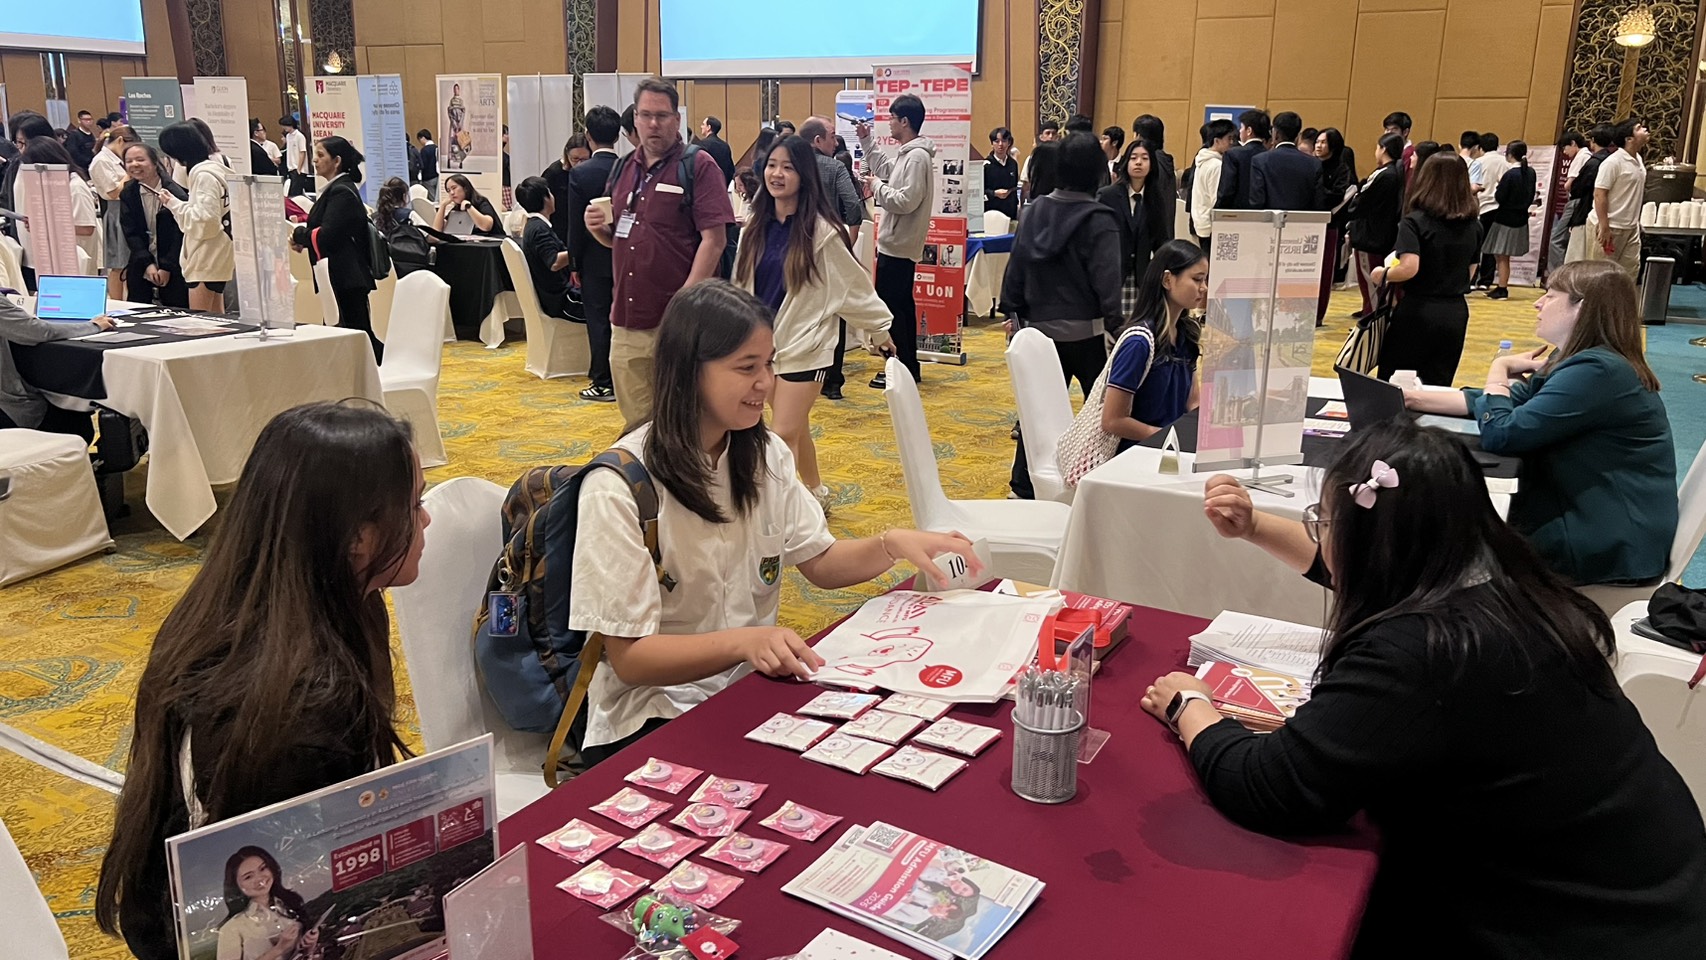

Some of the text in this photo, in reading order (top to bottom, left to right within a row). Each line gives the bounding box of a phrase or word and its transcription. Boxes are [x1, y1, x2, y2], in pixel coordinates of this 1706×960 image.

[312, 112, 346, 120] MACQUARIE
[926, 285, 953, 298] UoN
[936, 670, 957, 685] MFU
[334, 841, 373, 859] Established
[918, 842, 937, 857] MFU
[335, 848, 380, 876] 1998
[890, 856, 922, 894] Admission
[860, 892, 881, 908] 2026
[869, 893, 894, 910] Guide
